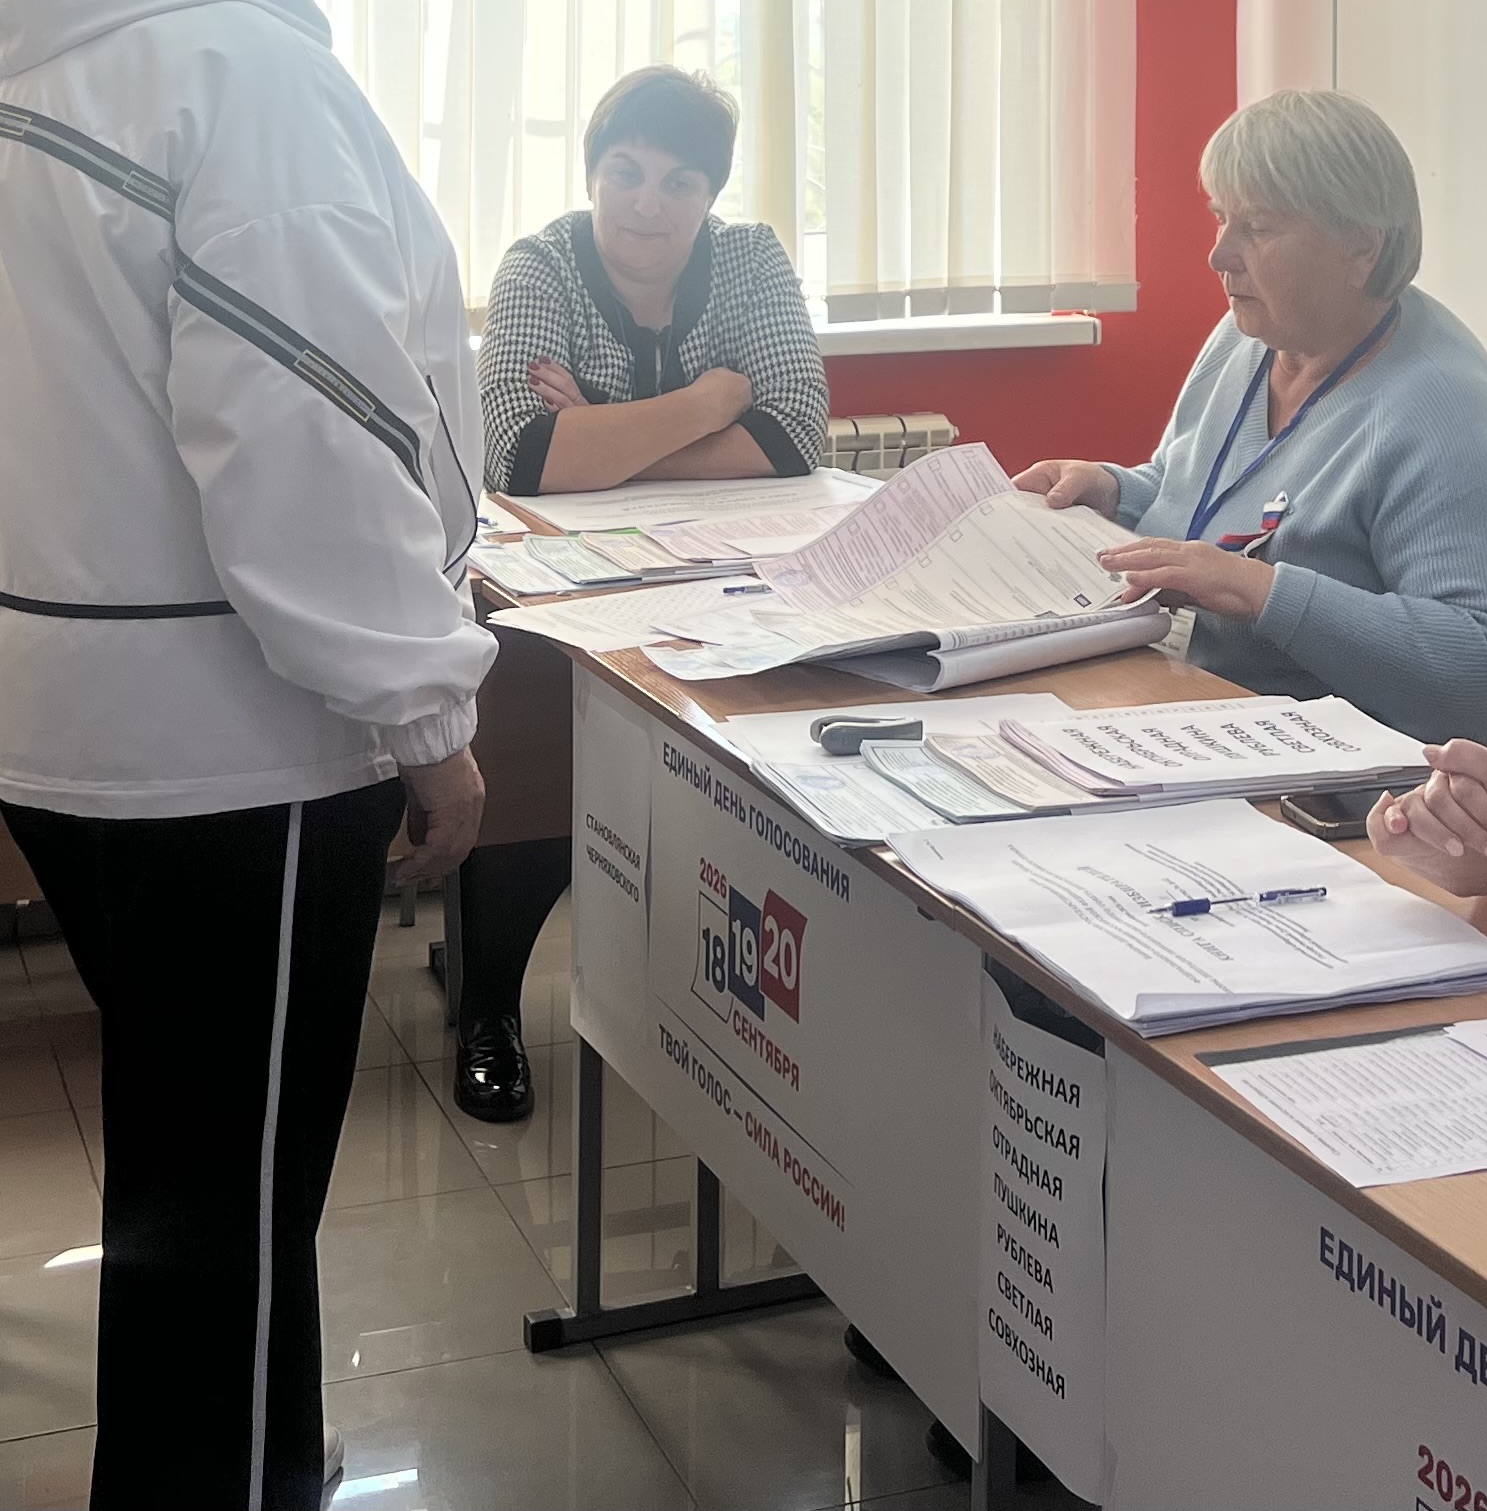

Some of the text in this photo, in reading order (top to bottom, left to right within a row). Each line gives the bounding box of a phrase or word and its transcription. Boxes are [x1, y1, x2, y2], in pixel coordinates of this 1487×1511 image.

[1220, 722, 1281, 757] РУБЛЕВА
[1254, 720, 1316, 754] СВЕТЛАЯ
[663, 741, 851, 903] ЕДИНЫЙ ДЕНЬ ГОЛОСОВАНИЯ
[699, 857, 728, 900] 2026
[702, 915, 798, 994] 18 19 20
[732, 1008, 800, 1092] СЕНТЯБРЯ
[658, 1023, 691, 1077] ТВОЙ
[691, 1055, 732, 1118] ГОЛОС
[744, 1110, 782, 1169] СИЛА
[783, 1144, 847, 1234] РОССИИ!
[989, 1068, 1081, 1160] ОКТЯБРЬСКАЯ
[992, 1123, 1064, 1202] ОТРАДНАЯ
[993, 1171, 1060, 1250] ПУШКИНА
[996, 1222, 1054, 1294] РУБЛЕВА
[1319, 1225, 1447, 1354] ЕДИНЫЙ
[997, 1270, 1054, 1342] СВЕТЛАЯ
[988, 1307, 1066, 1400] СОВХОЗНАЯ
